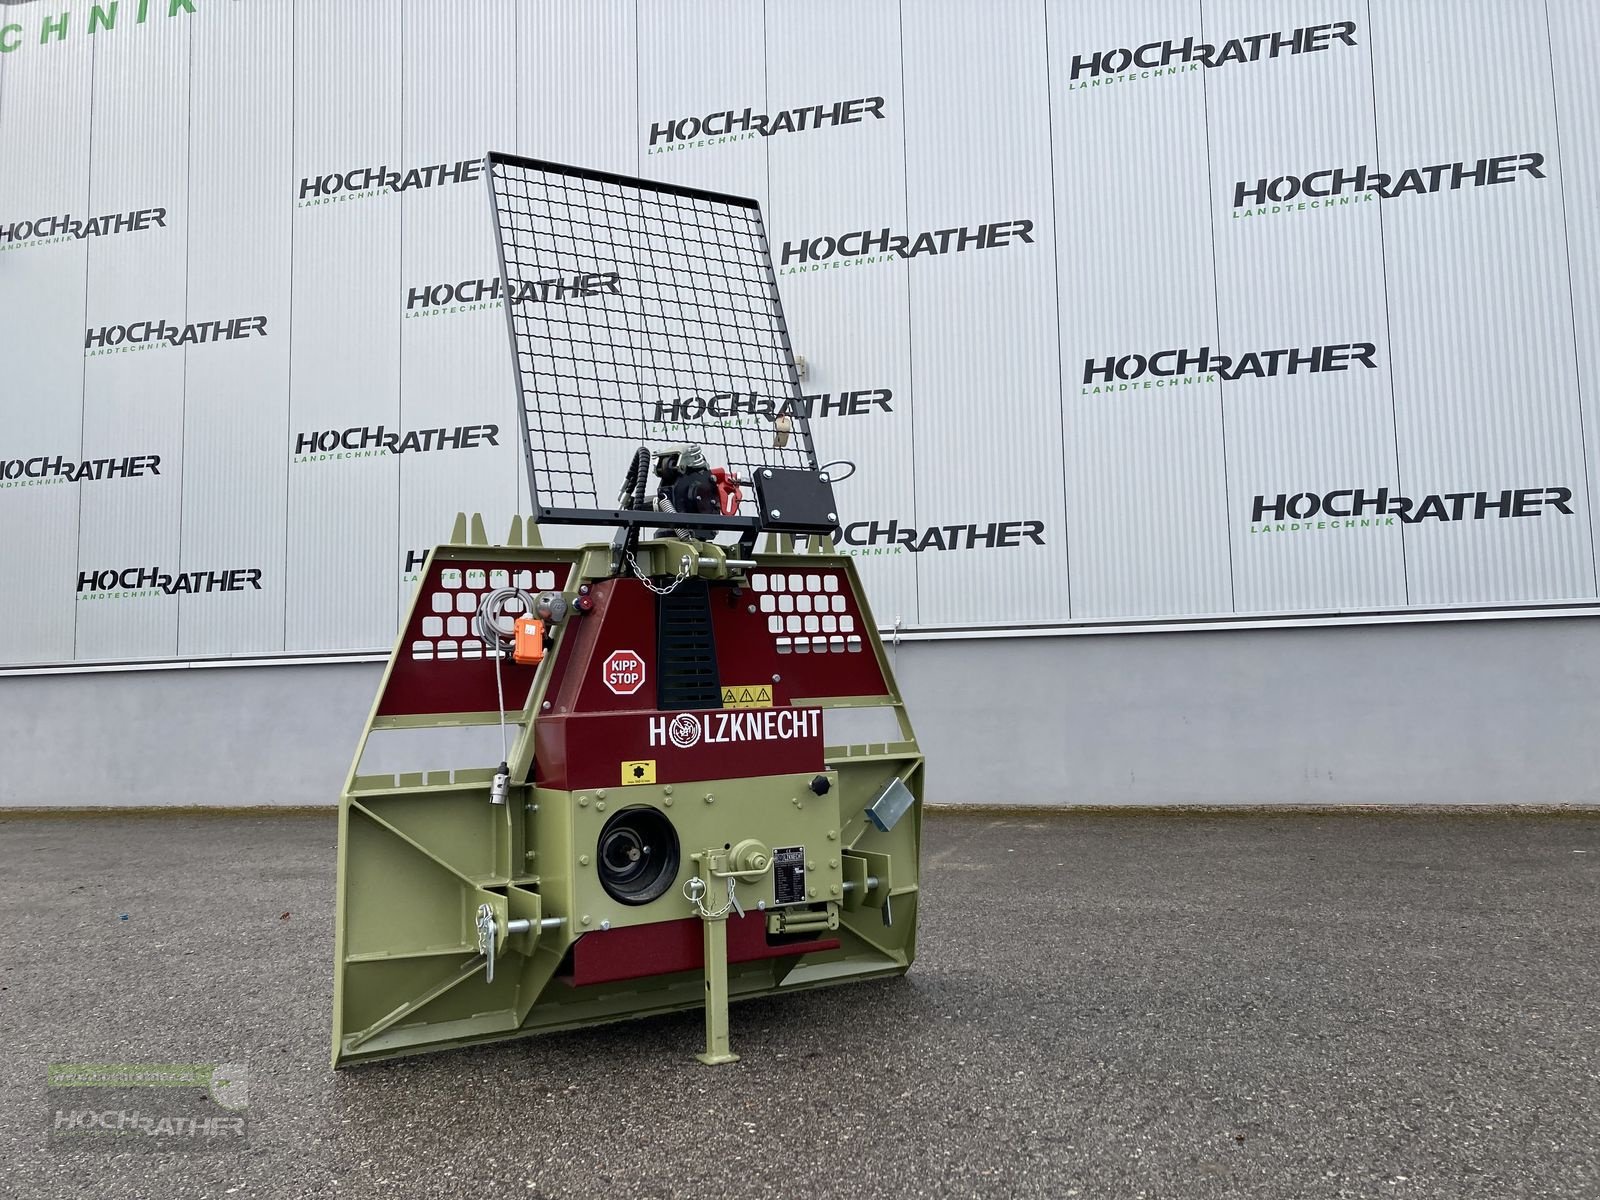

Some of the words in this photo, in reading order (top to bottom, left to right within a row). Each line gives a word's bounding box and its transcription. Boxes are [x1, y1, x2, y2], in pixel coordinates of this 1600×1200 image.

[1069, 20, 1358, 80] HOCHRATHER
[1068, 63, 1199, 90] LANDTECHNIK
[649, 96, 886, 146] HOCHRATHER
[648, 131, 756, 155] LANDTECHNIK
[1233, 152, 1547, 207] HOCHRATHER
[298, 188, 389, 208] LANDTECHNIK
[1233, 193, 1373, 219] LANDTECHNIK
[780, 219, 1035, 265] HOCHRATHER
[779, 254, 895, 275] LANDTECHNIK
[405, 301, 502, 319] LANDTECHNIK
[84, 315, 268, 349] HOCHRATHER
[83, 341, 168, 357] LANDTECHNIK
[1082, 341, 1378, 384] HOCHRATHER
[1082, 374, 1215, 395] LANDTECHNIK
[653, 388, 893, 422] HOCHRATHER
[295, 424, 500, 456] HOCHRATHER
[294, 448, 387, 463] LANDTECHNIK
[1251, 486, 1575, 523] HOCHRATHER
[1250, 516, 1394, 534] LANDTECHNIK
[76, 566, 262, 596] HOCHRATHER
[75, 588, 161, 602] LANDTECHNIK
[609, 673, 639, 684] STOP
[611, 660, 637, 671] KIPP
